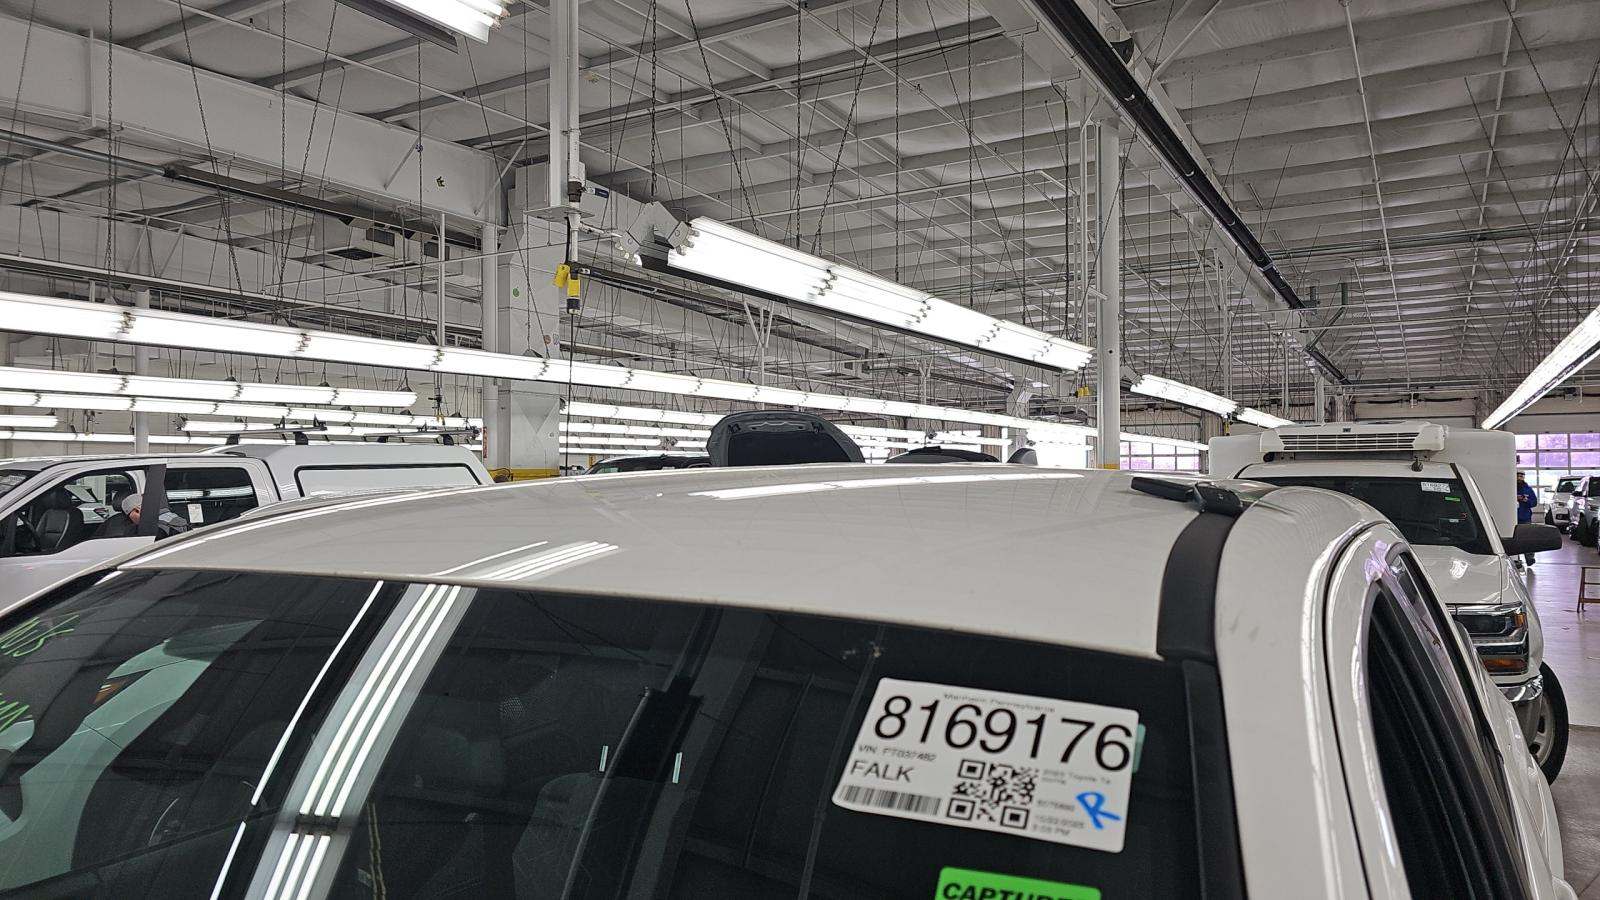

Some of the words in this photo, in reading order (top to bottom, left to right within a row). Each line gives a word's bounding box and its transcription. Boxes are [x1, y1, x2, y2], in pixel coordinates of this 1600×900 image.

[874, 695, 1133, 772] 8169176
[851, 760, 914, 783] FALK
[1076, 791, 1121, 830] R
[943, 882, 1073, 900] CAPTU
